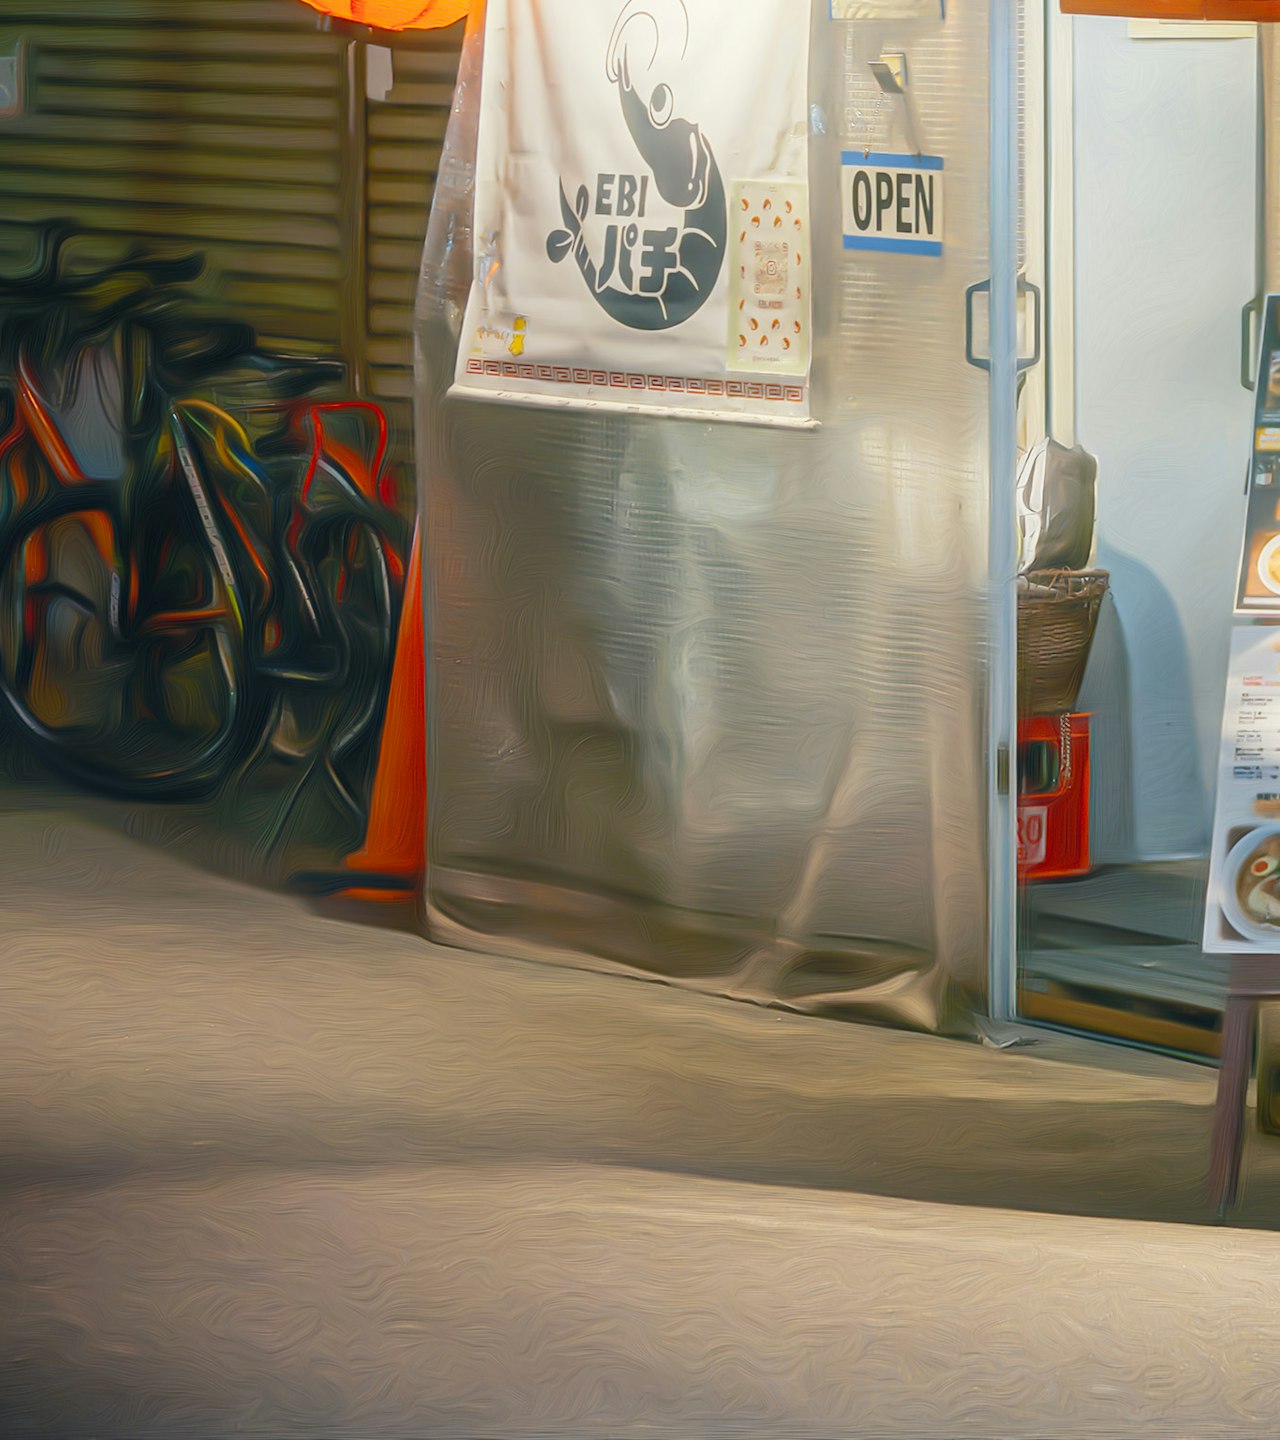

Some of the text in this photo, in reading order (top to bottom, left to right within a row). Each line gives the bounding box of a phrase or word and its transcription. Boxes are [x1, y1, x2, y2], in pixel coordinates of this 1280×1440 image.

[595, 173, 648, 218] EBI
[851, 171, 934, 236] OPEN
[597, 225, 680, 296] パチ
